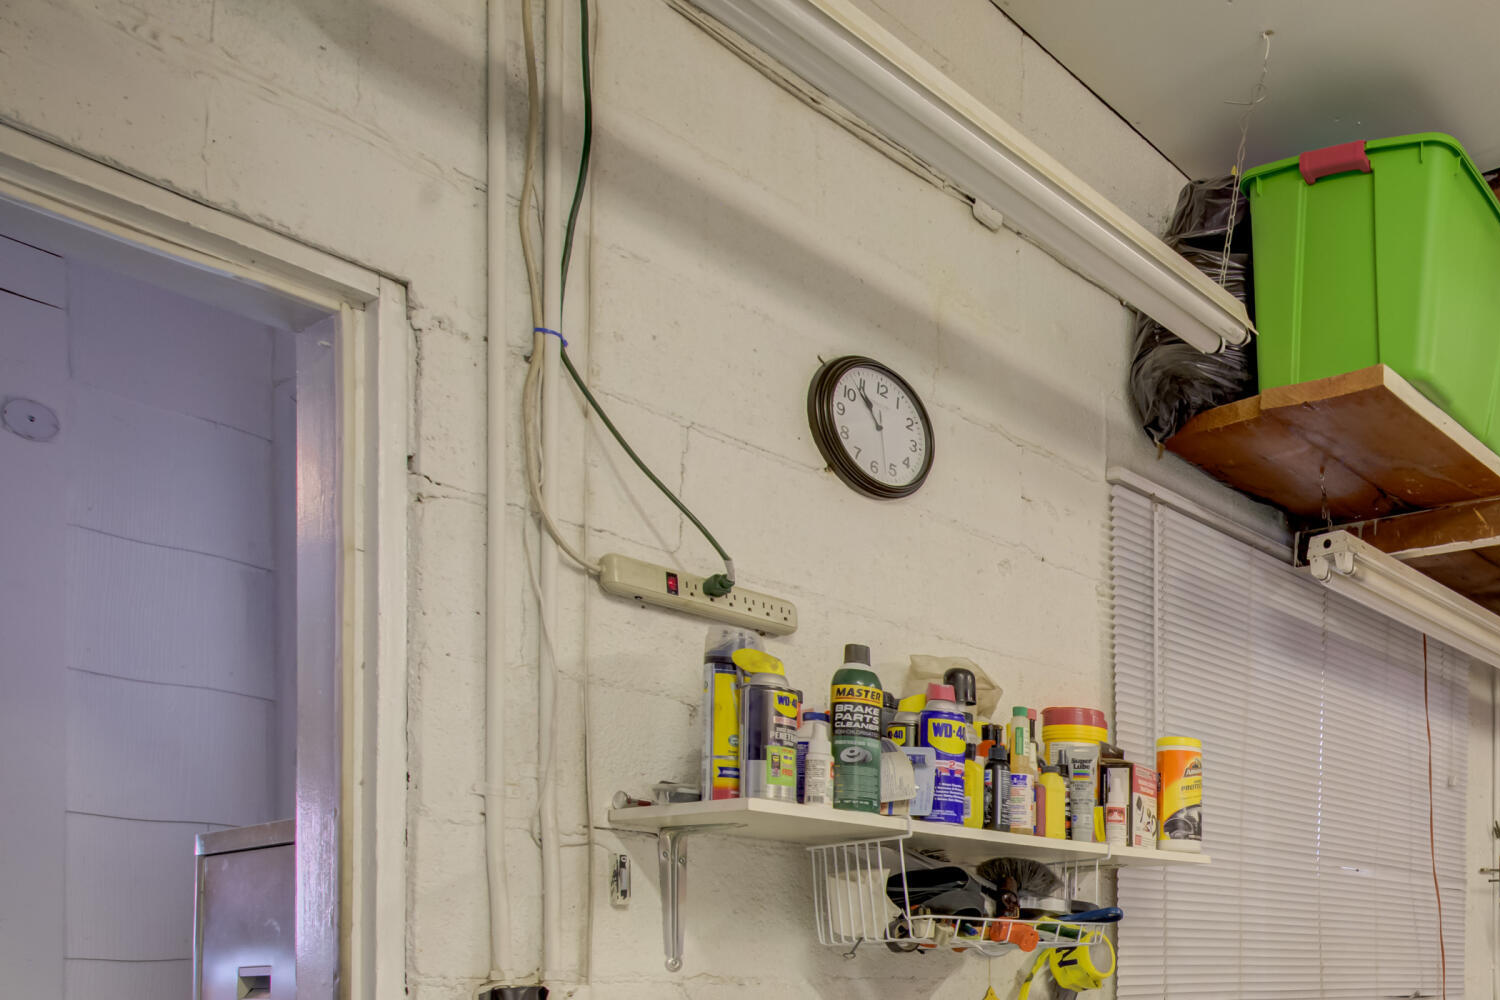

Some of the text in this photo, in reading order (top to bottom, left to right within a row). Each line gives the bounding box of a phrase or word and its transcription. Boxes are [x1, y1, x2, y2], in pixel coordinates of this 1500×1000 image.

[843, 385, 857, 402] 10
[876, 381, 889, 399] 12
[836, 402, 846, 416] 9
[905, 417, 914, 431] 2
[840, 425, 850, 440] 8
[853, 446, 862, 459] 7
[909, 439, 917, 453] 3
[870, 460, 879, 474] 6
[888, 463, 897, 477] 5
[902, 457, 910, 469] 4
[835, 687, 881, 701] MASTER
[835, 704, 880, 716] BRAKE
[835, 713, 879, 724] PARTS
[834, 721, 880, 731] CLEANER
[1071, 758, 1092, 766] Super
